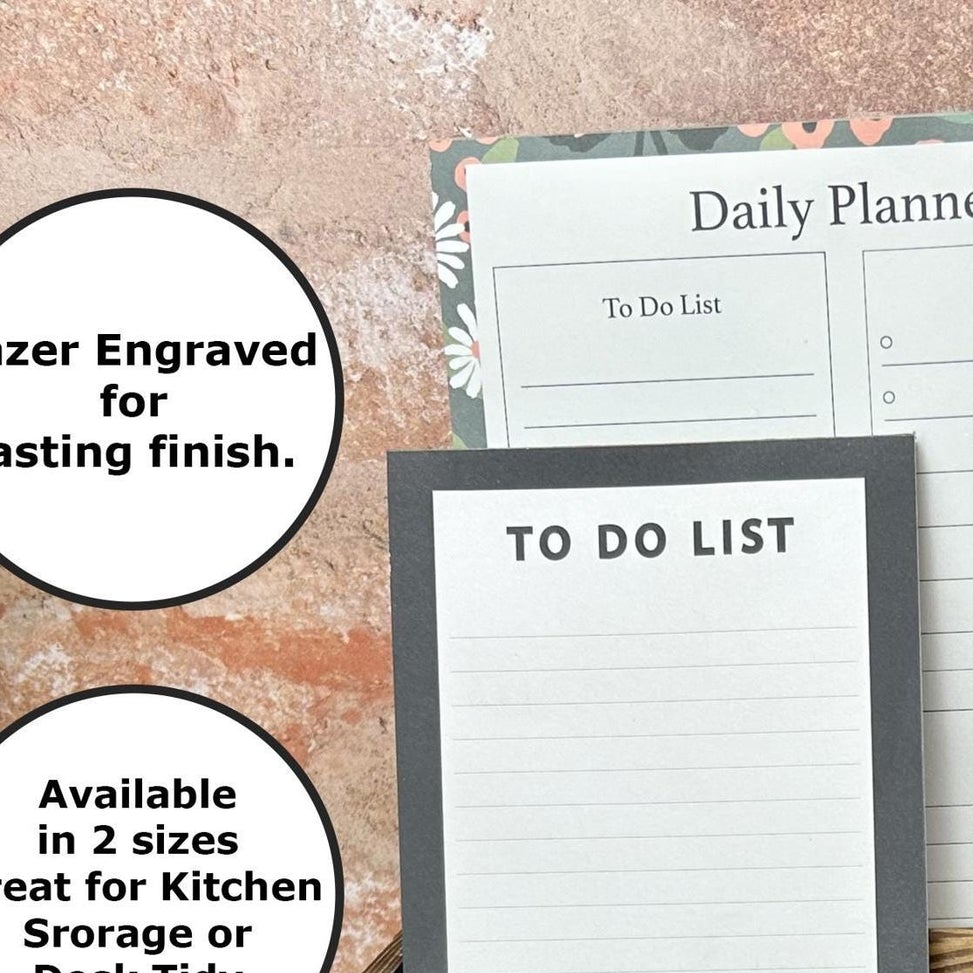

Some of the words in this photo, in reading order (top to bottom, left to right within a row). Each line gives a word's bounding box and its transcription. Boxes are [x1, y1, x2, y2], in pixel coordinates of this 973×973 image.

[689, 184, 815, 241] Daily
[601, 296, 633, 319] To
[638, 295, 674, 318] Do
[679, 293, 722, 316] List
[506, 525, 571, 561] TO
[598, 522, 667, 560] DO
[693, 517, 795, 556] LIST
